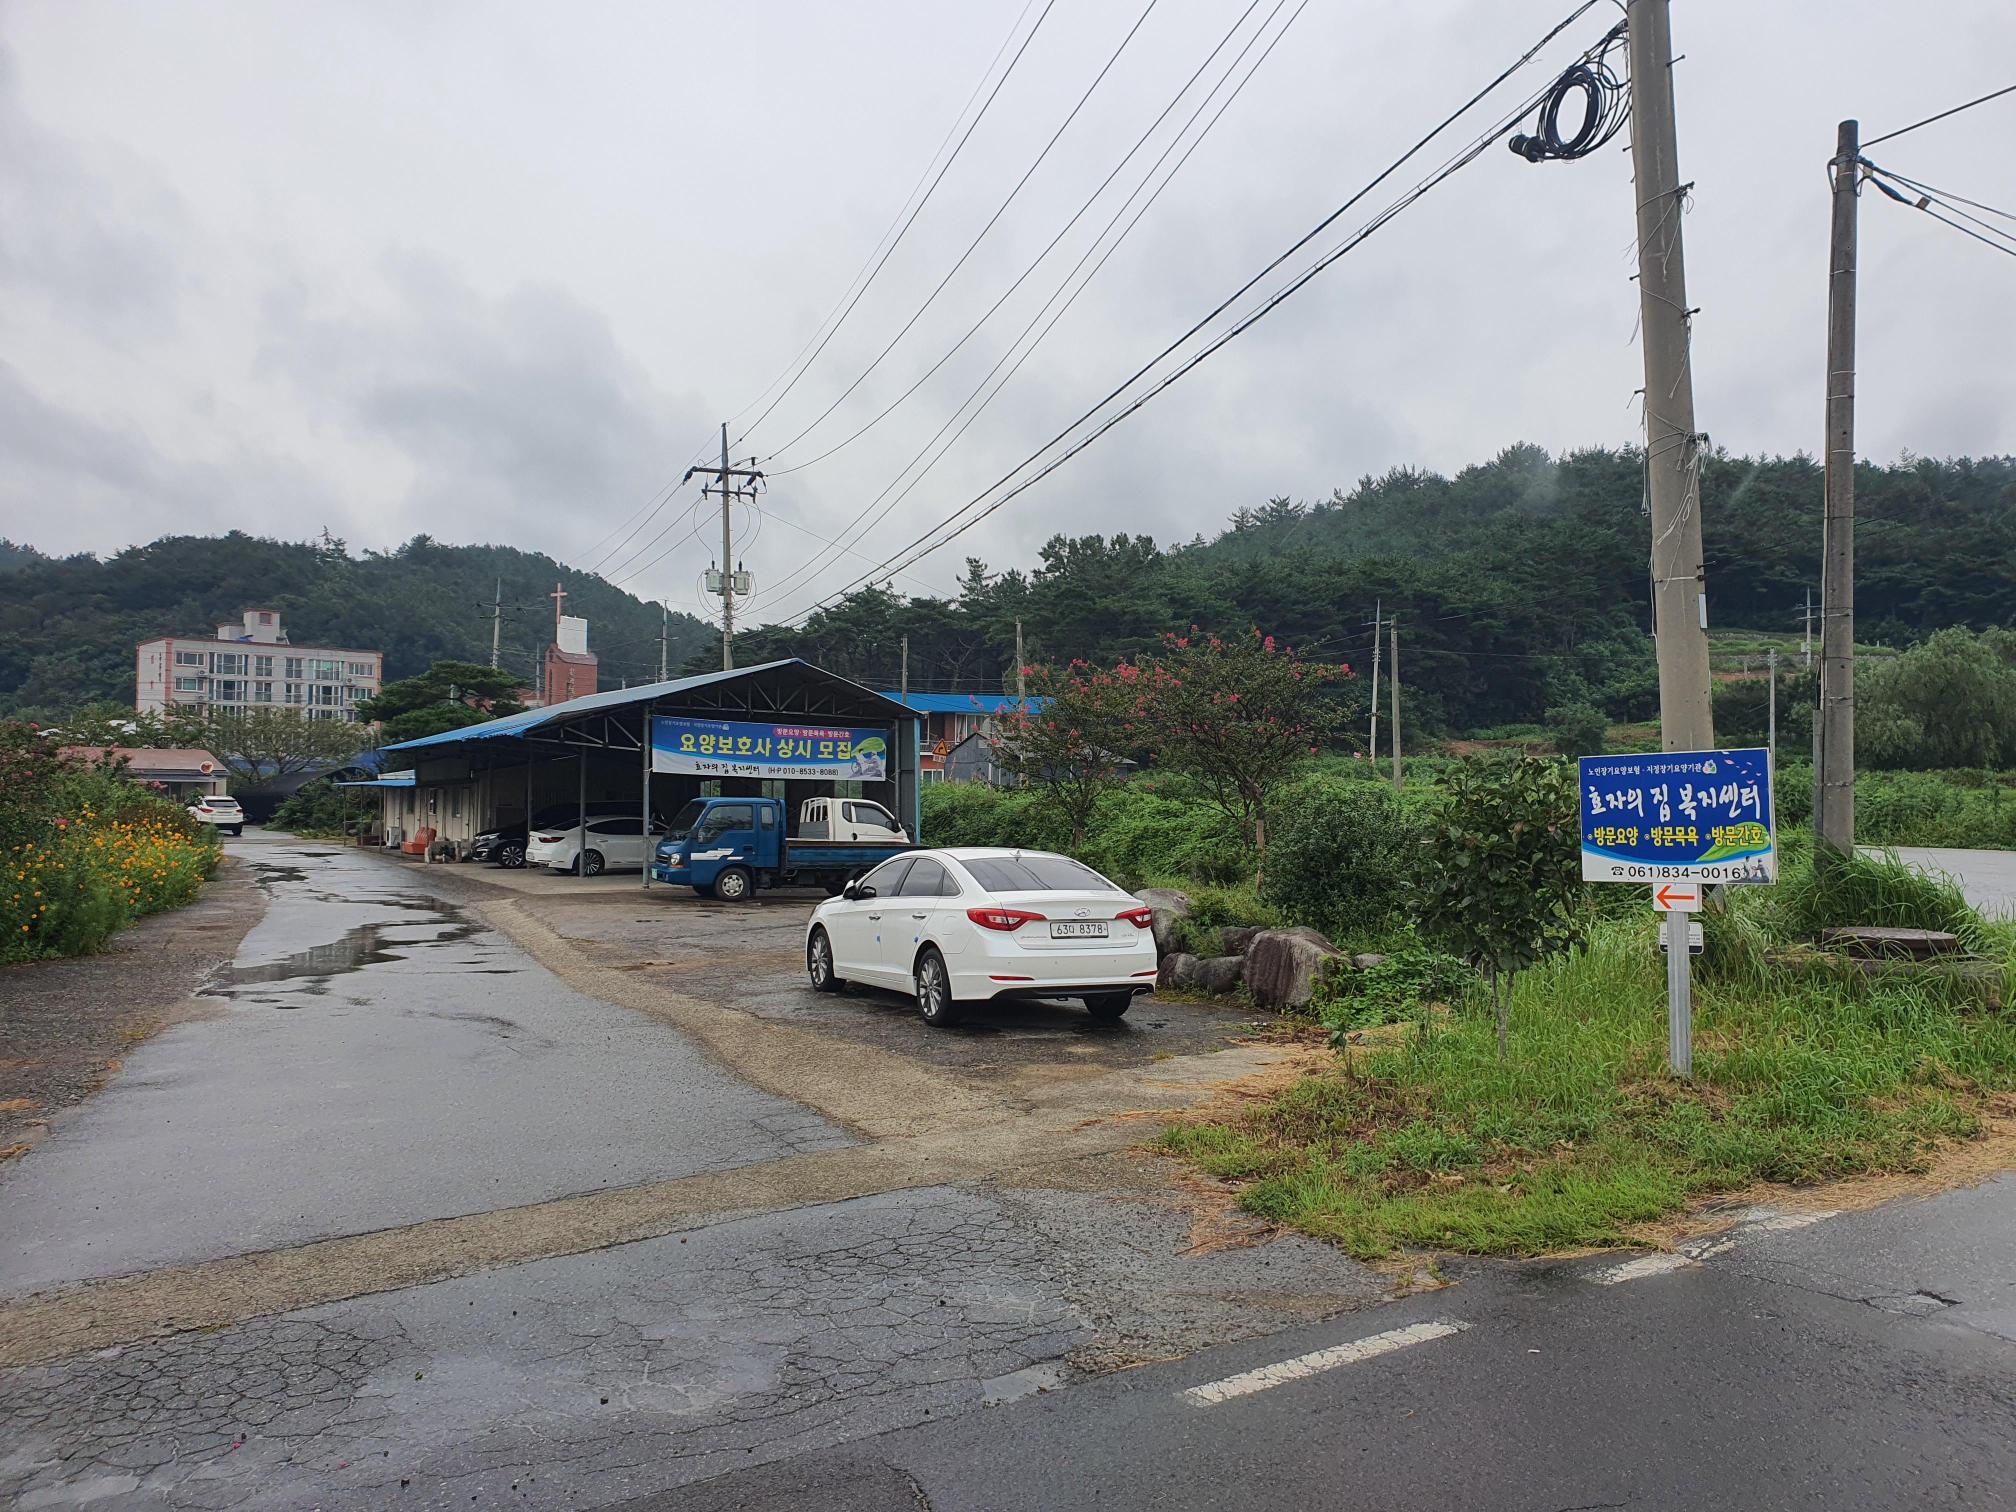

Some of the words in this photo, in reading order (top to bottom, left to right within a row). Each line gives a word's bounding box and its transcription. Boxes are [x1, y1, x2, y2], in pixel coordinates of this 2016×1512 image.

[680, 733, 772, 757] 요양보호사
[776, 737, 812, 759] 상시
[817, 740, 852, 760] 모집
[721, 762, 729, 775] 집
[1587, 765, 1641, 776] 노인장기요양보험
[1646, 762, 1702, 774] 지정장기요양기관
[1588, 784, 1644, 817] 효자의
[1650, 783, 1671, 823] 집
[1593, 826, 1639, 847] 방문요양
[1650, 825, 1699, 847] 방문목욕
[1711, 825, 1764, 847] 방문간호
[1628, 865, 1741, 880] 061)834-0016
[1079, 923, 1103, 934] 8378
